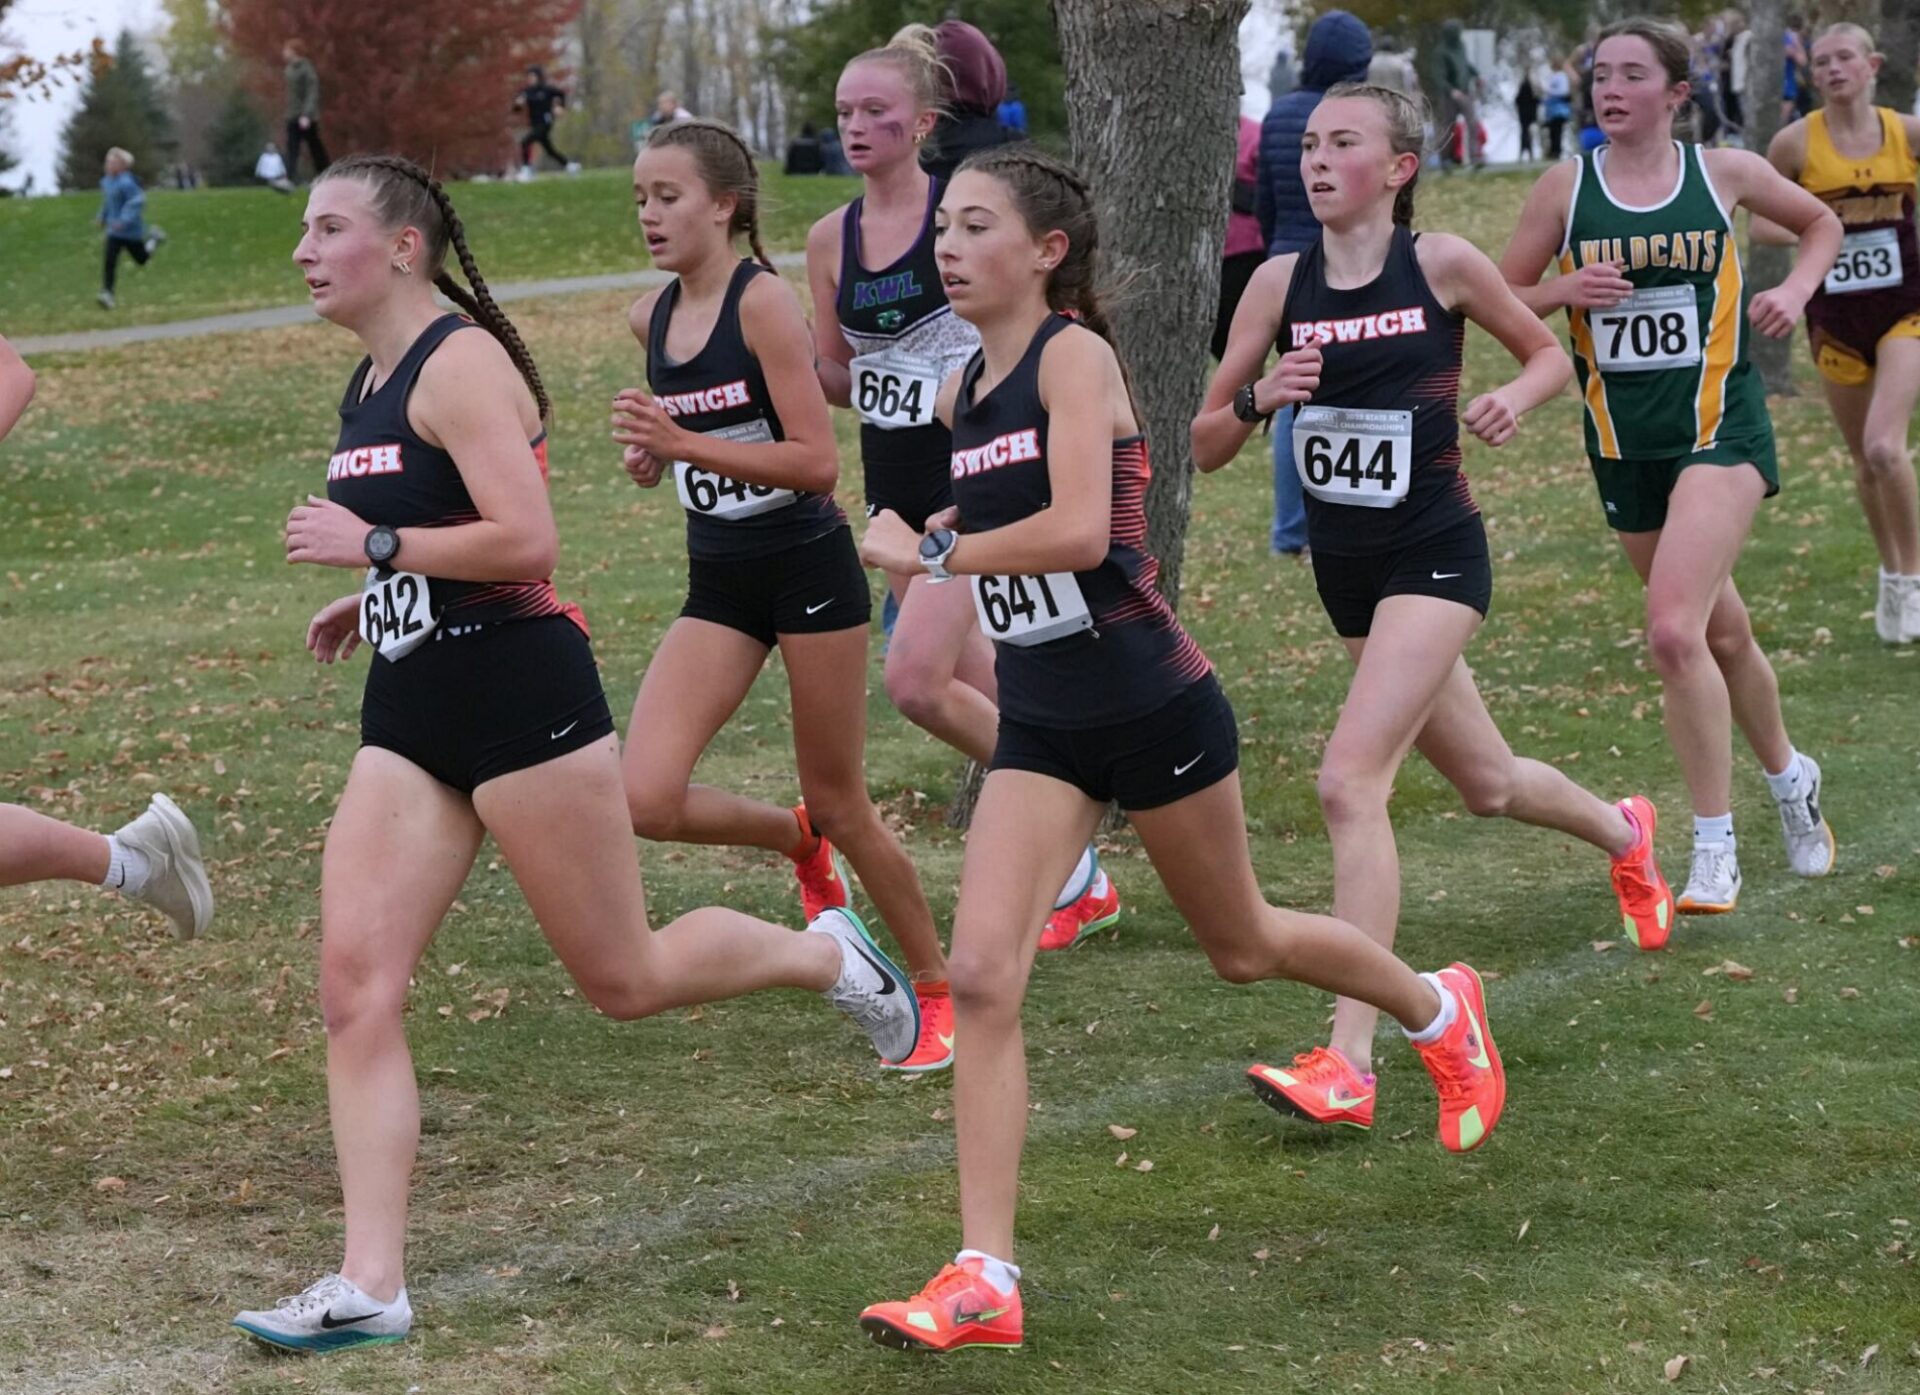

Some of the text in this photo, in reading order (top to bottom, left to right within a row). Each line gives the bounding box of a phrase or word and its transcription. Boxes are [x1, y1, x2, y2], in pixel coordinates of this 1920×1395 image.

[1580, 230, 1717, 273] WILDCATS
[1833, 248, 1892, 283] 563
[853, 271, 923, 310] KWL
[1602, 312, 1688, 359] 708
[859, 369, 923, 423] 664
[327, 442, 404, 481] WICH
[951, 427, 1041, 481] SWICH
[1304, 435, 1397, 491] 644
[364, 574, 424, 647] 642
[978, 574, 1060, 634] 641
